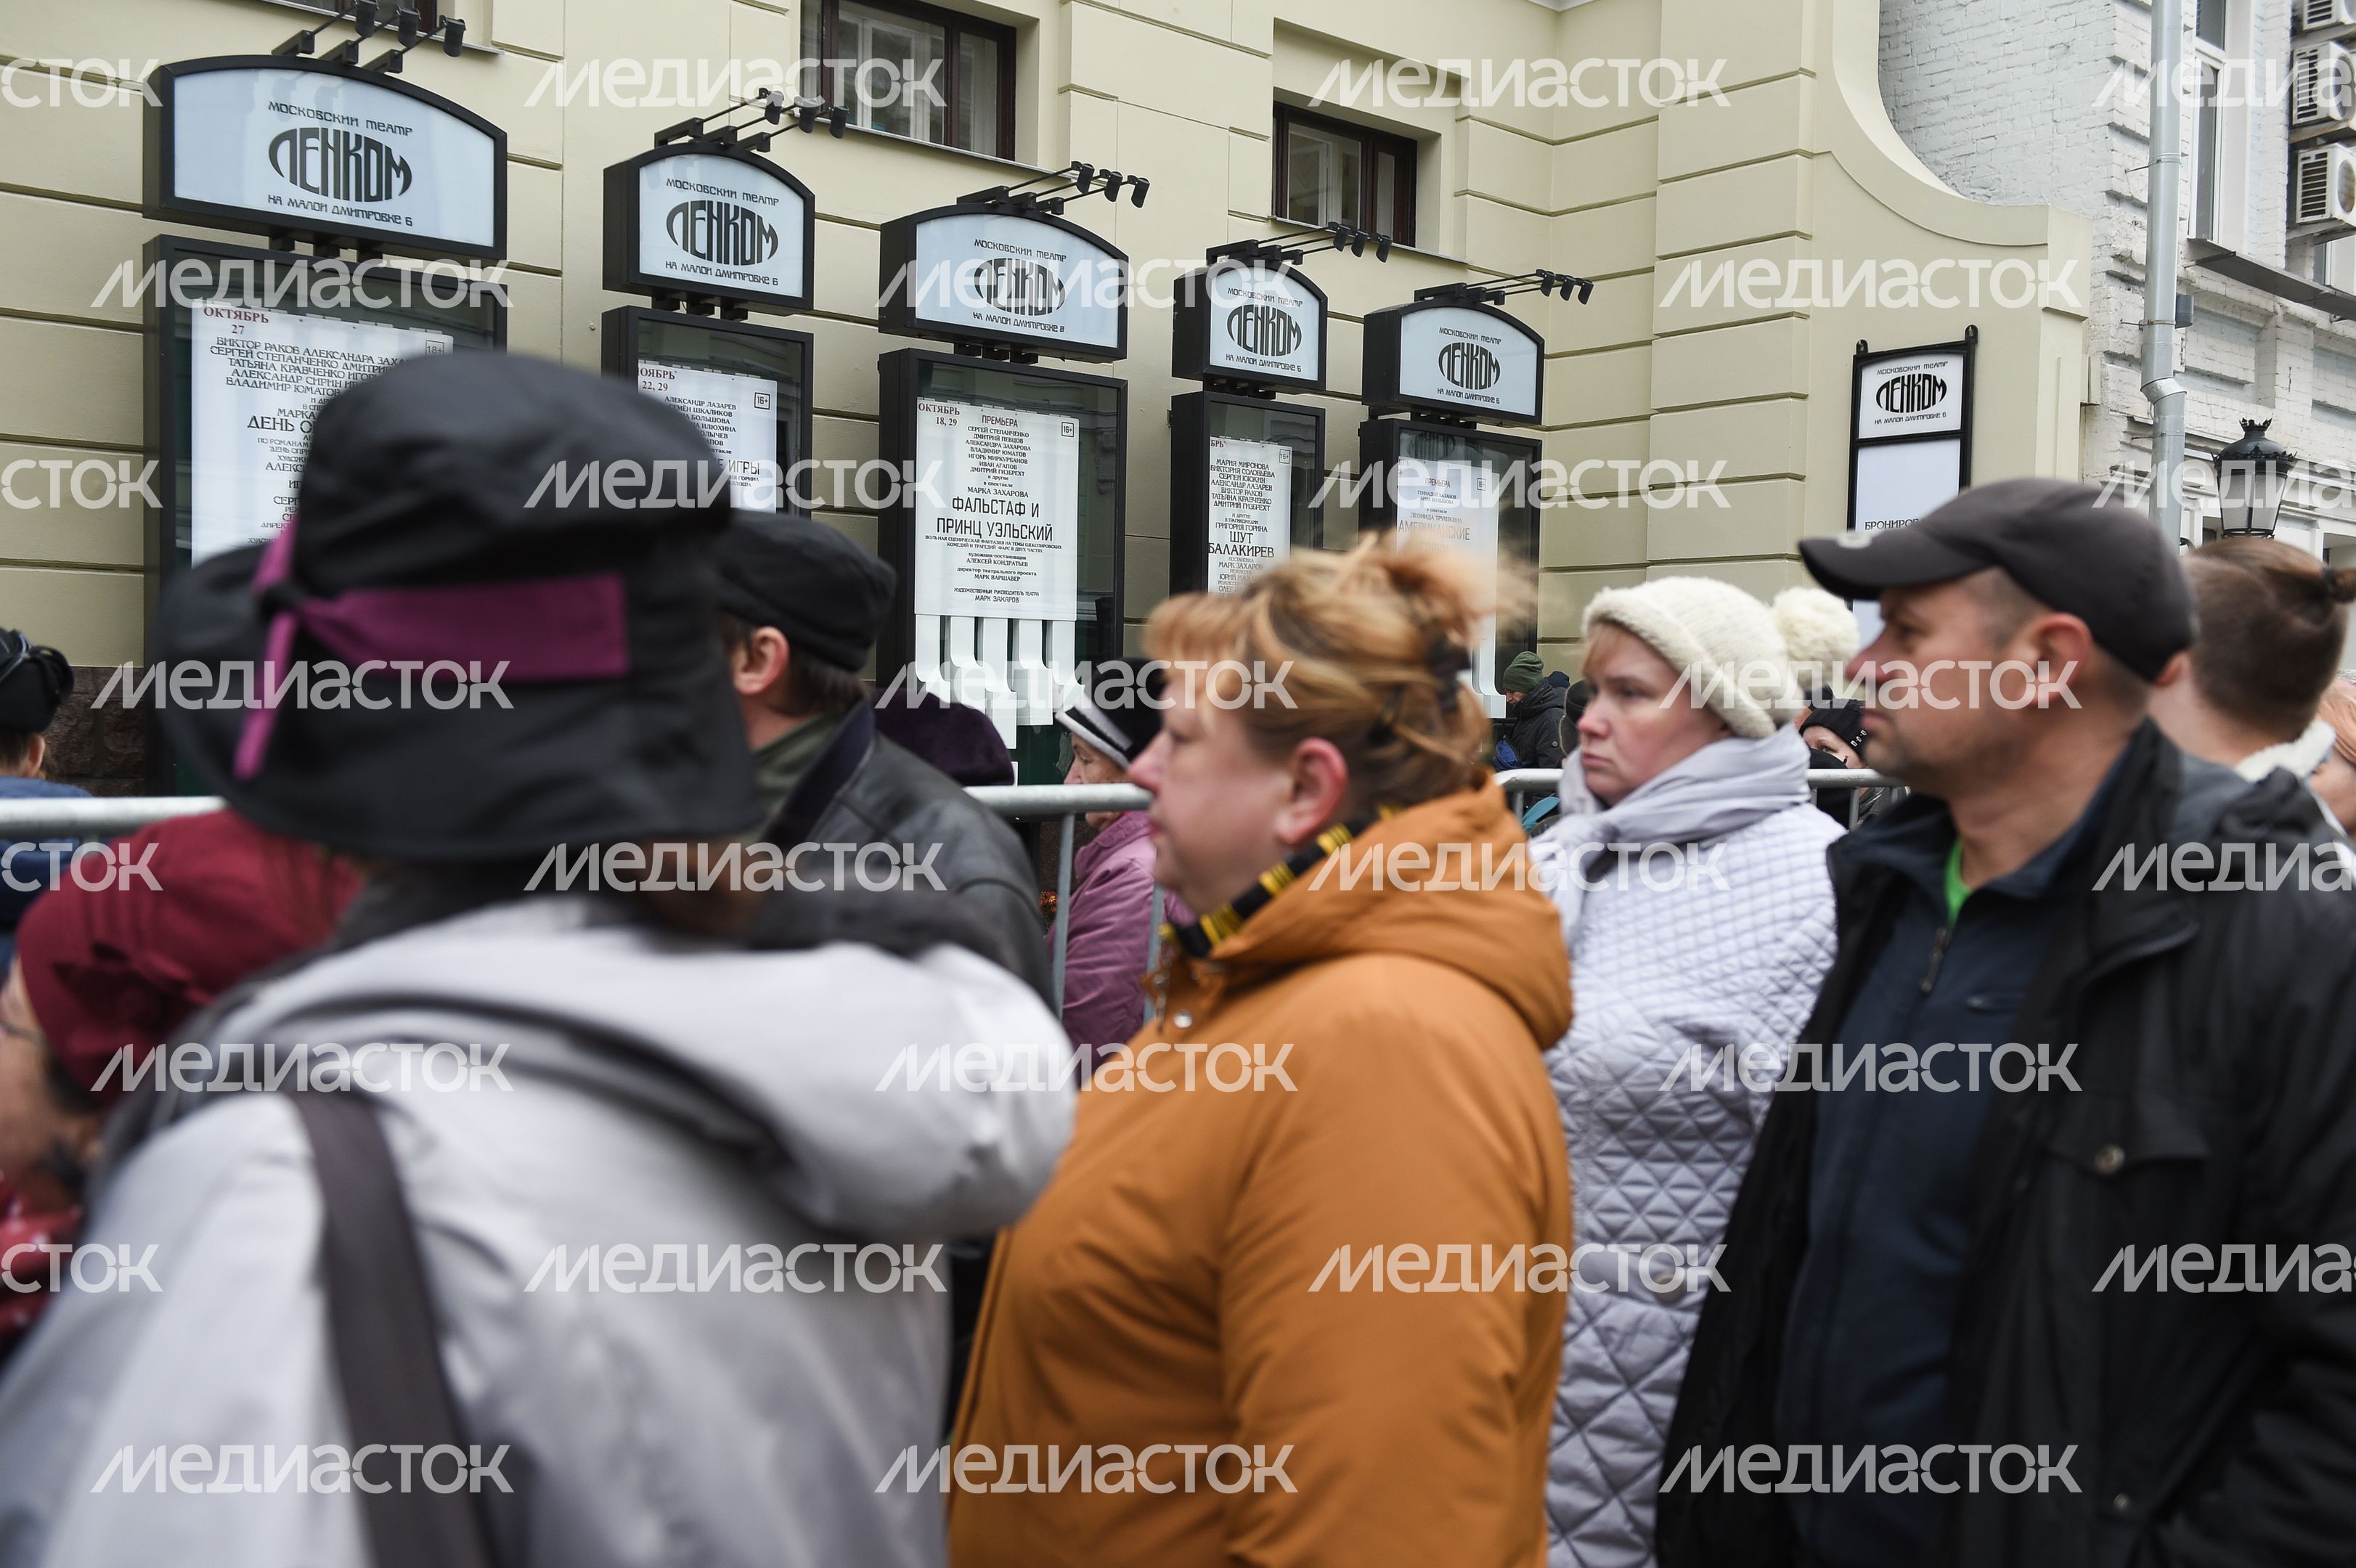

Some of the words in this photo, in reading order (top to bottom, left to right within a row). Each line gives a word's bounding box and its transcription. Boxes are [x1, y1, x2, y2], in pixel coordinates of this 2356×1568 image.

[269, 102, 358, 126] МОСКОВСКИЙ
[366, 120, 412, 136] ТЕАТР
[269, 127, 412, 202] ЛЕНКОМ
[667, 178, 737, 198] МОСКОВСКИЙ
[743, 192, 779, 206] ТЕАТР
[268, 195, 282, 205] НА
[288, 198, 327, 212] МАЛОЙ
[332, 205, 401, 224] ДМИТРОВКЕ
[666, 200, 778, 266] ЛЕНКОМ
[974, 239, 1032, 256] МОСКОВСКИЙ
[1037, 250, 1067, 261] ТЕАТР
[681, 264, 712, 276] МАЛОЙ
[715, 269, 770, 285] ДМИТРОВКЕ
[974, 258, 1066, 316] ЛЕНКОМ
[1228, 287, 1275, 303] МОСКОВСКИЙ
[203, 306, 269, 323] ОКТЯБРЬ
[232, 324, 244, 334] 27
[1014, 319, 1058, 332] ДМИТРОВКЕ
[1227, 304, 1302, 356] ЛЕНКОМ
[1439, 327, 1478, 340] МОСКОВСКИЙ
[211, 346, 253, 359] СЕРГЕЙ
[257, 351, 338, 369] СТЕПАНЧЕНКО
[216, 337, 261, 349] ВИКТОР
[264, 343, 299, 354] РАКОВ
[303, 348, 374, 364] АЛЕКСАНДРА
[228, 358, 277, 371] ТАТЬЯНА
[281, 364, 345, 379] КРАВЧЕНКО
[1438, 342, 1500, 390] ЛЕНКОМ
[232, 369, 303, 383] АЛЕКСАНДР
[306, 377, 341, 388] СИРИН
[639, 367, 675, 380] ОЯБРЬ
[226, 377, 290, 391] ВЛАДИМИР
[642, 380, 655, 391] 22,
[658, 383, 668, 391] 29
[1876, 374, 1947, 413] ЛЕНКОМ
[665, 396, 705, 406] АЛЕКСАНДР
[706, 401, 736, 410] ЛАЗАРЕВ
[918, 403, 960, 415] ОКТЯБРЬ
[277, 409, 315, 420] МАРКА
[691, 415, 730, 424] БОЛЬШОВА
[693, 408, 733, 417] ШКАЛИКОВ
[248, 415, 295, 431] ДЕНЬ
[936, 417, 947, 426] 18,
[982, 415, 1018, 428] ПРЕМЬЕРА
[990, 428, 1029, 437] СТЕПАНЧЕНКО
[1063, 425, 1073, 433] 16+
[966, 439, 1001, 448] АЛЕКСАНДРА
[987, 455, 1028, 464] МИРКУРБАНОВ
[1239, 462, 1269, 470] МИРОНОВА
[729, 460, 759, 475] ИГРЫ
[1210, 465, 1240, 474] ВИКТОРИЯ
[1242, 468, 1275, 478] СОЛОВЬЕВА
[1211, 479, 1246, 488] АЛЕКСАНДР
[993, 489, 1028, 497] ЗАХАРОВА
[953, 497, 1025, 516] ФАЛЬСТАФ
[1032, 503, 1039, 518] И
[1239, 496, 1271, 505] КРАВЧЕНКО
[937, 518, 982, 539] ПРИНЦ
[987, 521, 1053, 541] УЭЛЬСКИЙ
[1230, 531, 1253, 543] ШУТ
[1209, 543, 1274, 558] БАЛАКИРЕВ
